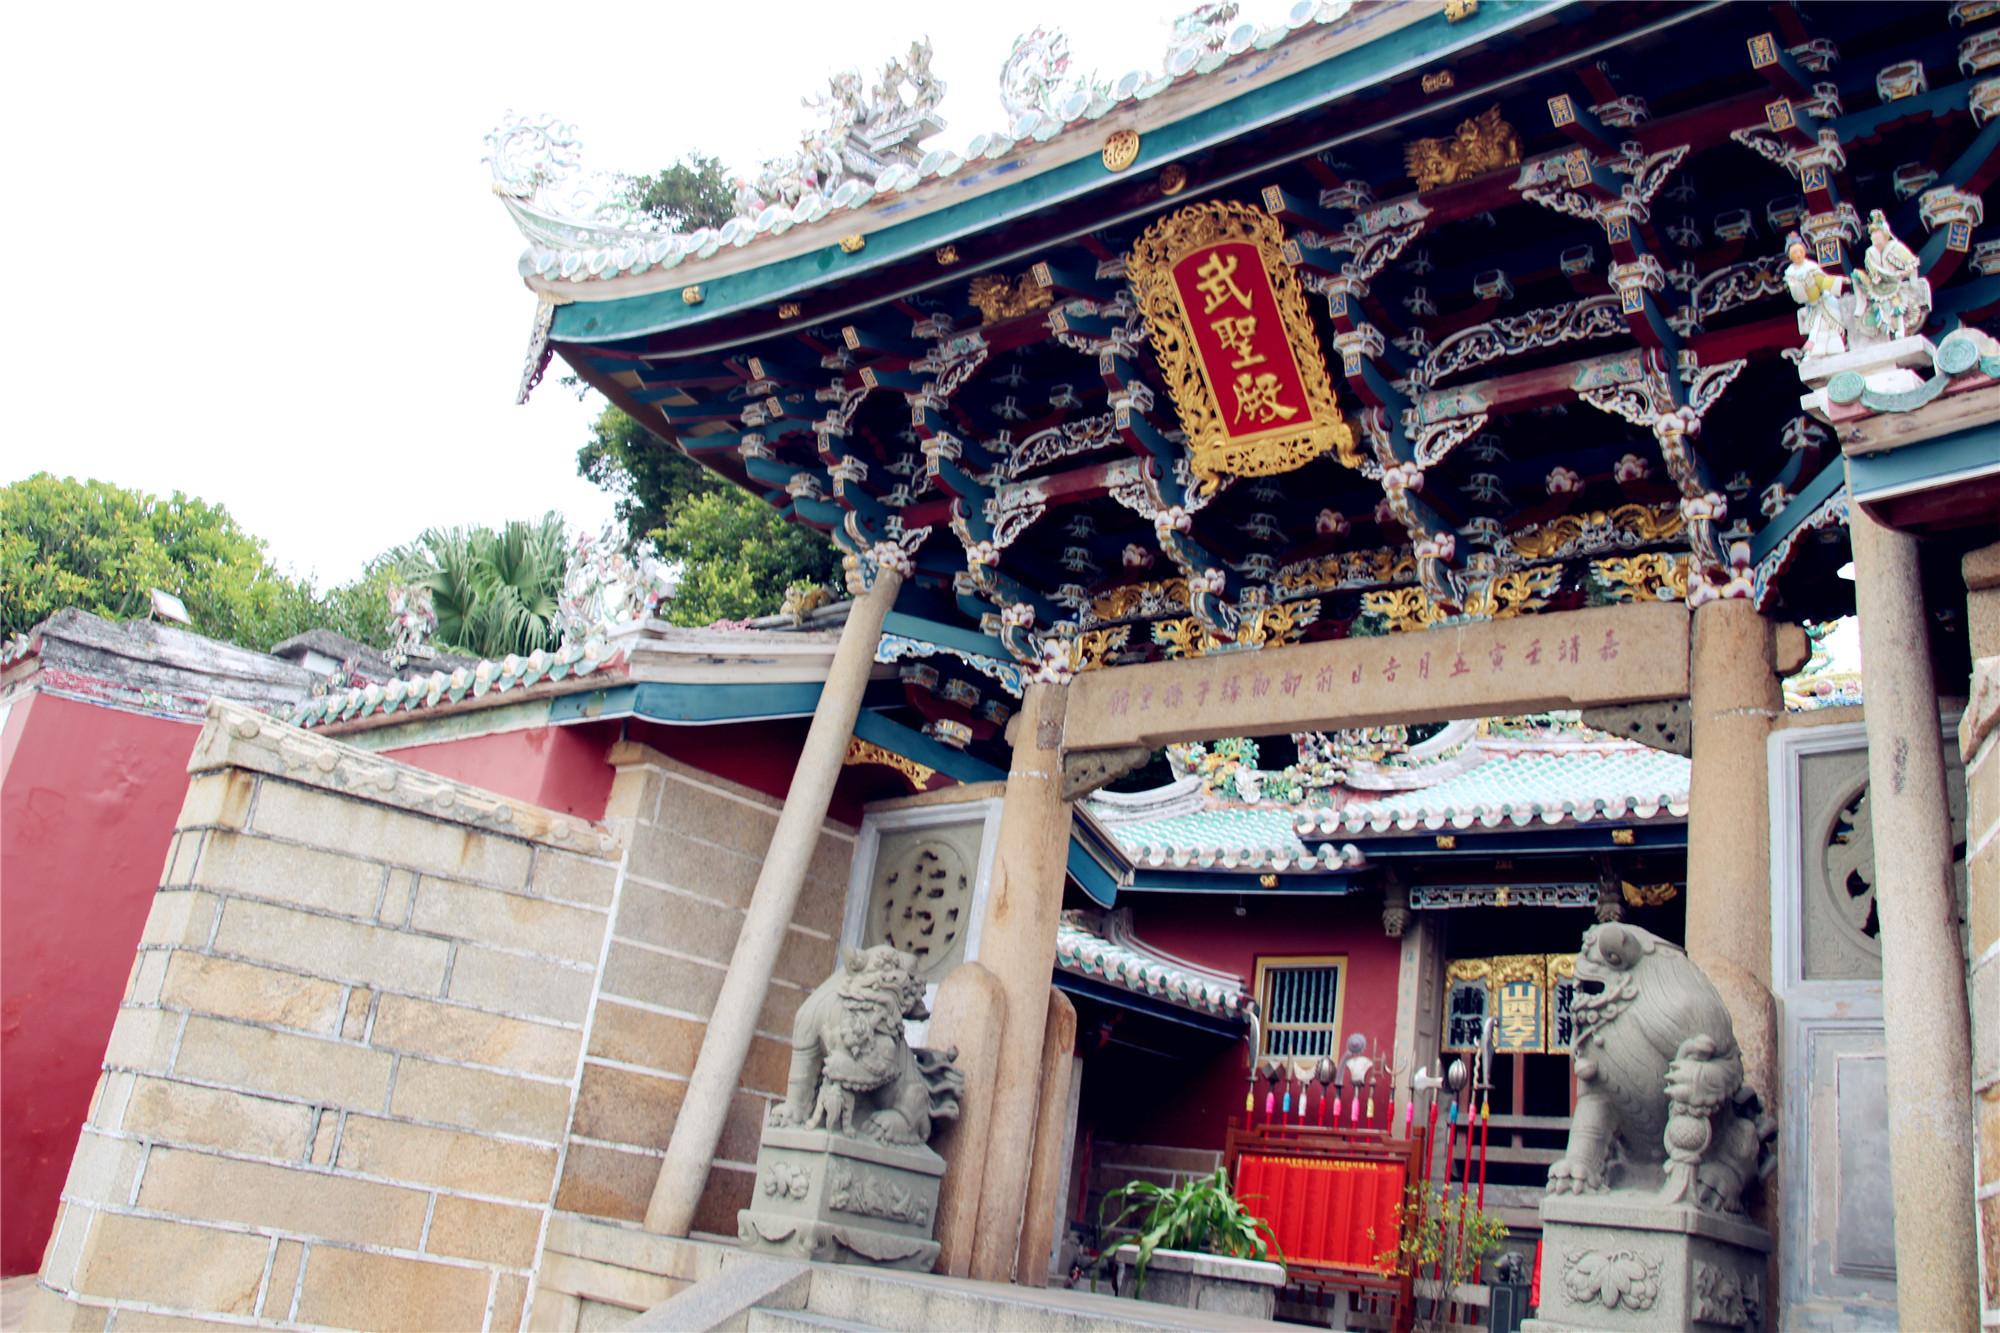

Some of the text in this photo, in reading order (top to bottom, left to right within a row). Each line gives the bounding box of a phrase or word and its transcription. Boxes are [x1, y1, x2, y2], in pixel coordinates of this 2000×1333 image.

[1196, 251, 1298, 425] 武聖殿
[1501, 984, 1537, 1048] 山西夫子
